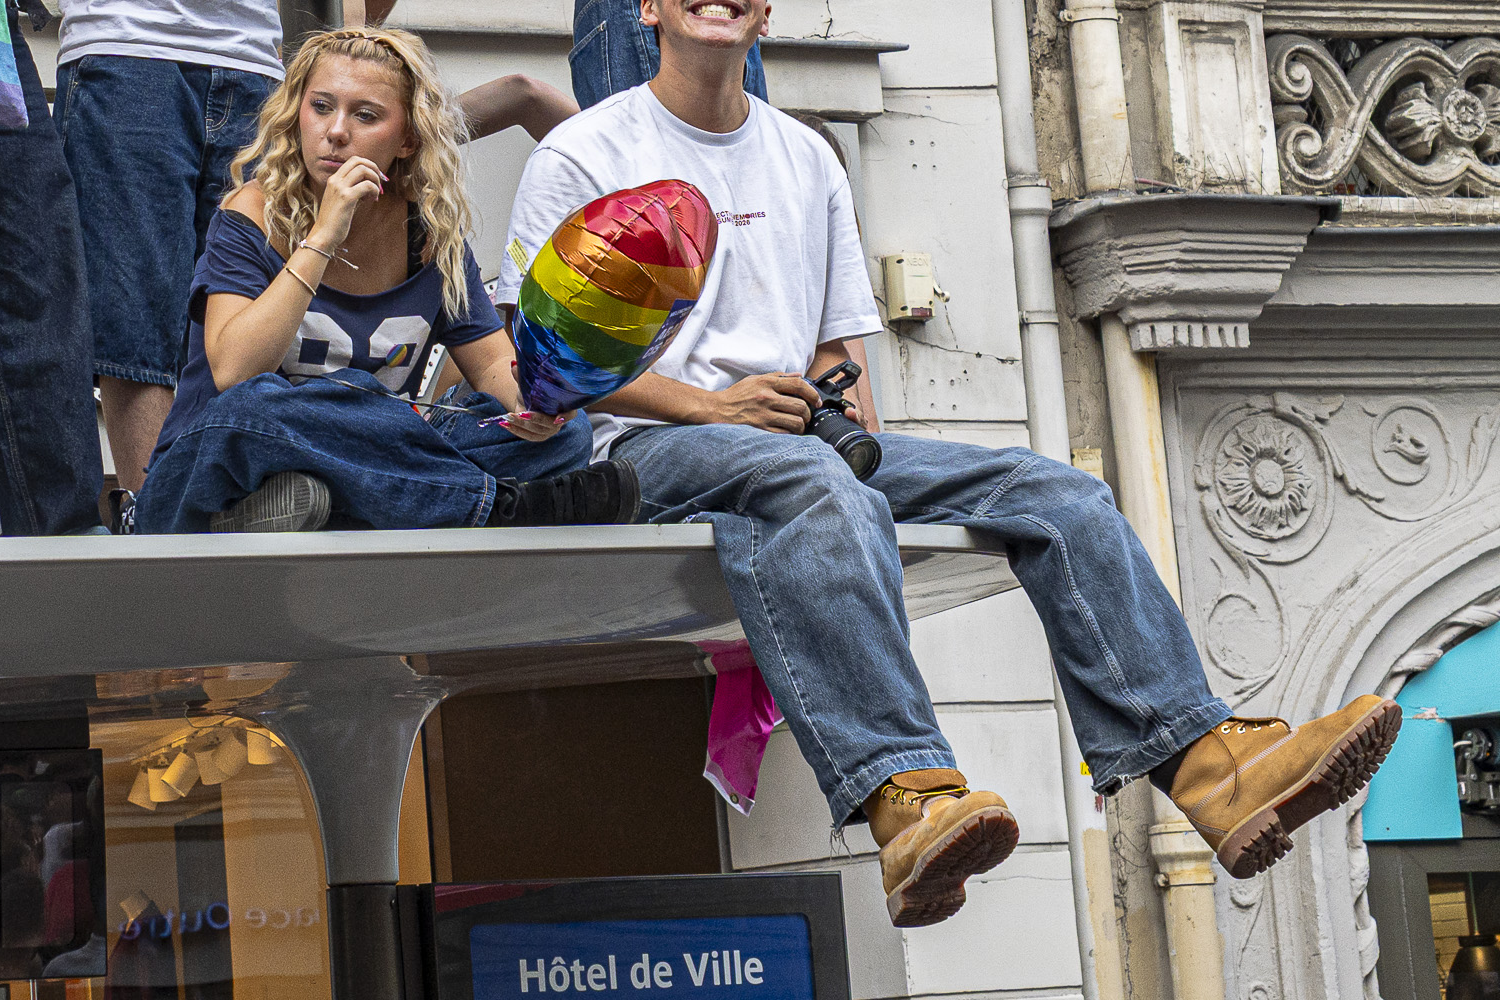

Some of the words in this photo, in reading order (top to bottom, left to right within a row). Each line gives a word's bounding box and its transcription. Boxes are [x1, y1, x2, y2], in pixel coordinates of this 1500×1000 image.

[518, 954, 618, 994] Hôtel
[630, 953, 673, 989] de
[683, 950, 764, 987] Ville
